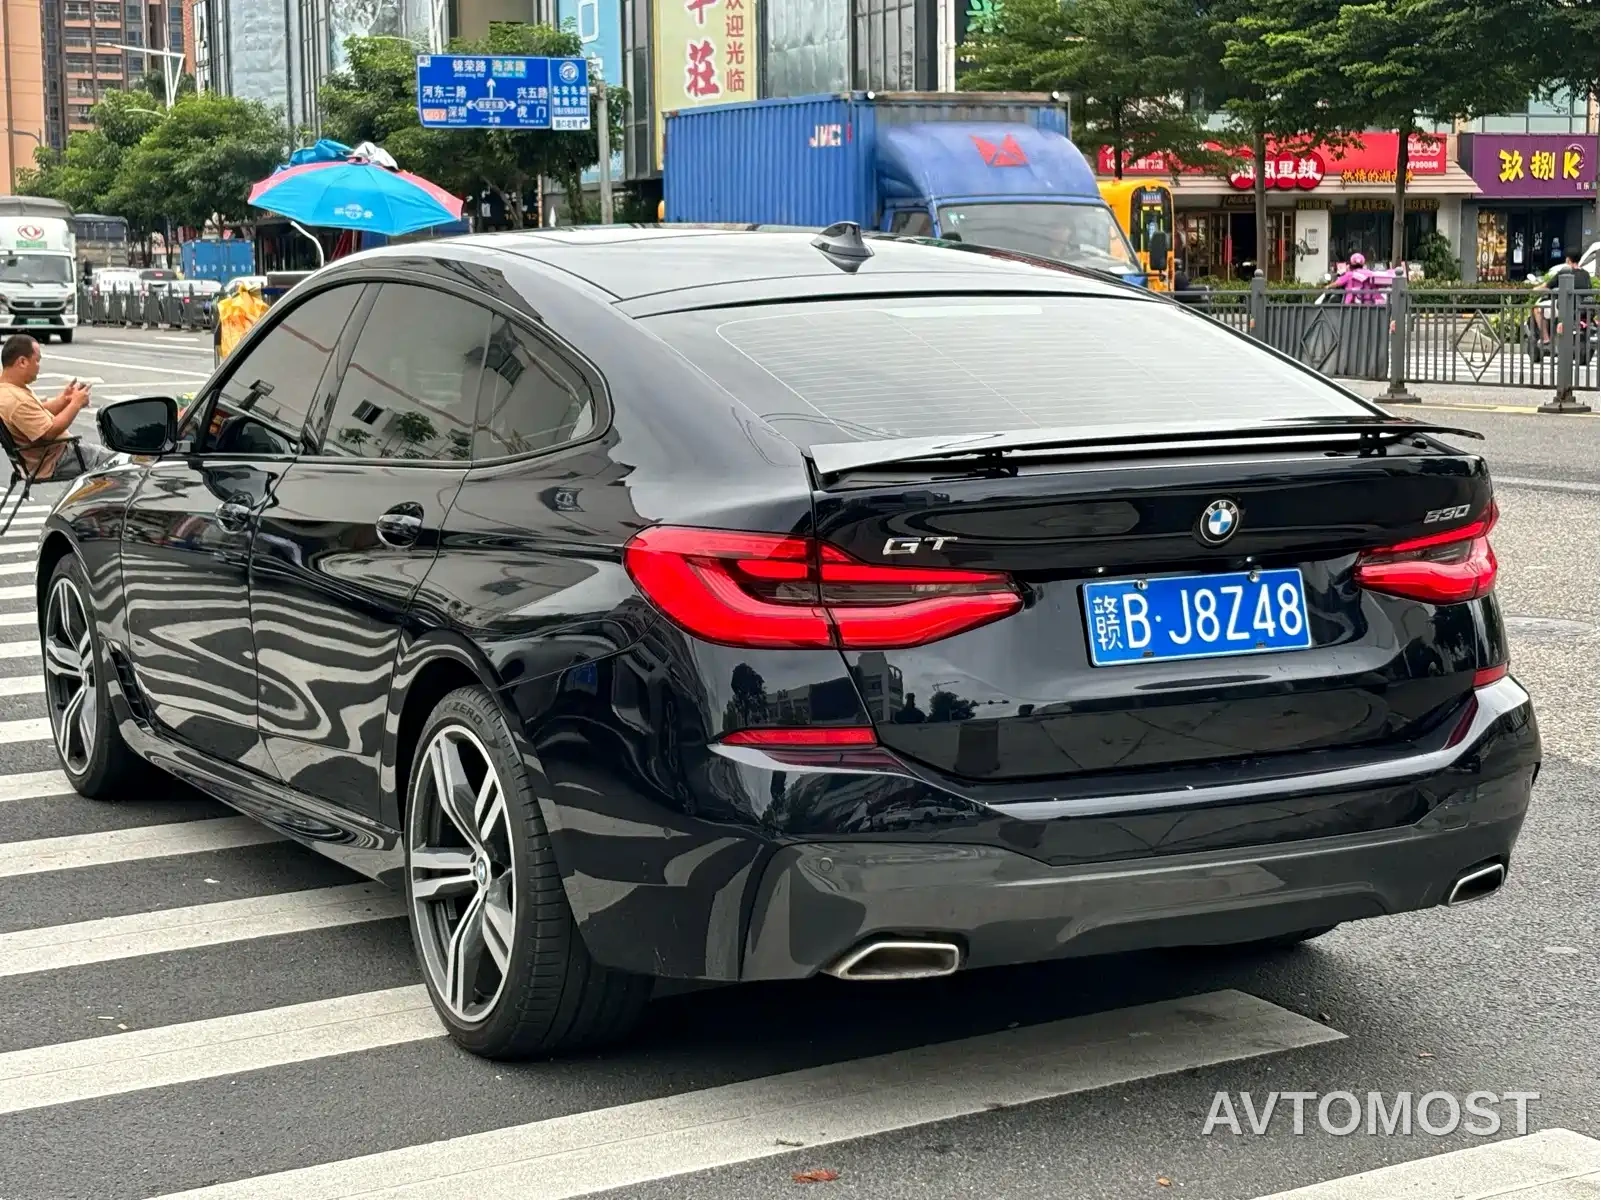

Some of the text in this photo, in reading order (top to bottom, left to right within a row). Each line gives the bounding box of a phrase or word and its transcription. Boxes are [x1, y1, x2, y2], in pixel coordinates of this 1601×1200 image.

[453, 60, 486, 72] 锦荣路
[423, 85, 467, 98] 河东二路
[517, 87, 548, 99] 兴五路
[447, 106, 467, 118] 深圳
[1499, 149, 1581, 182] 玖捌K
[1423, 503, 1471, 524] 630
[882, 536, 958, 555] GT
[452, 701, 483, 726] ZERO
